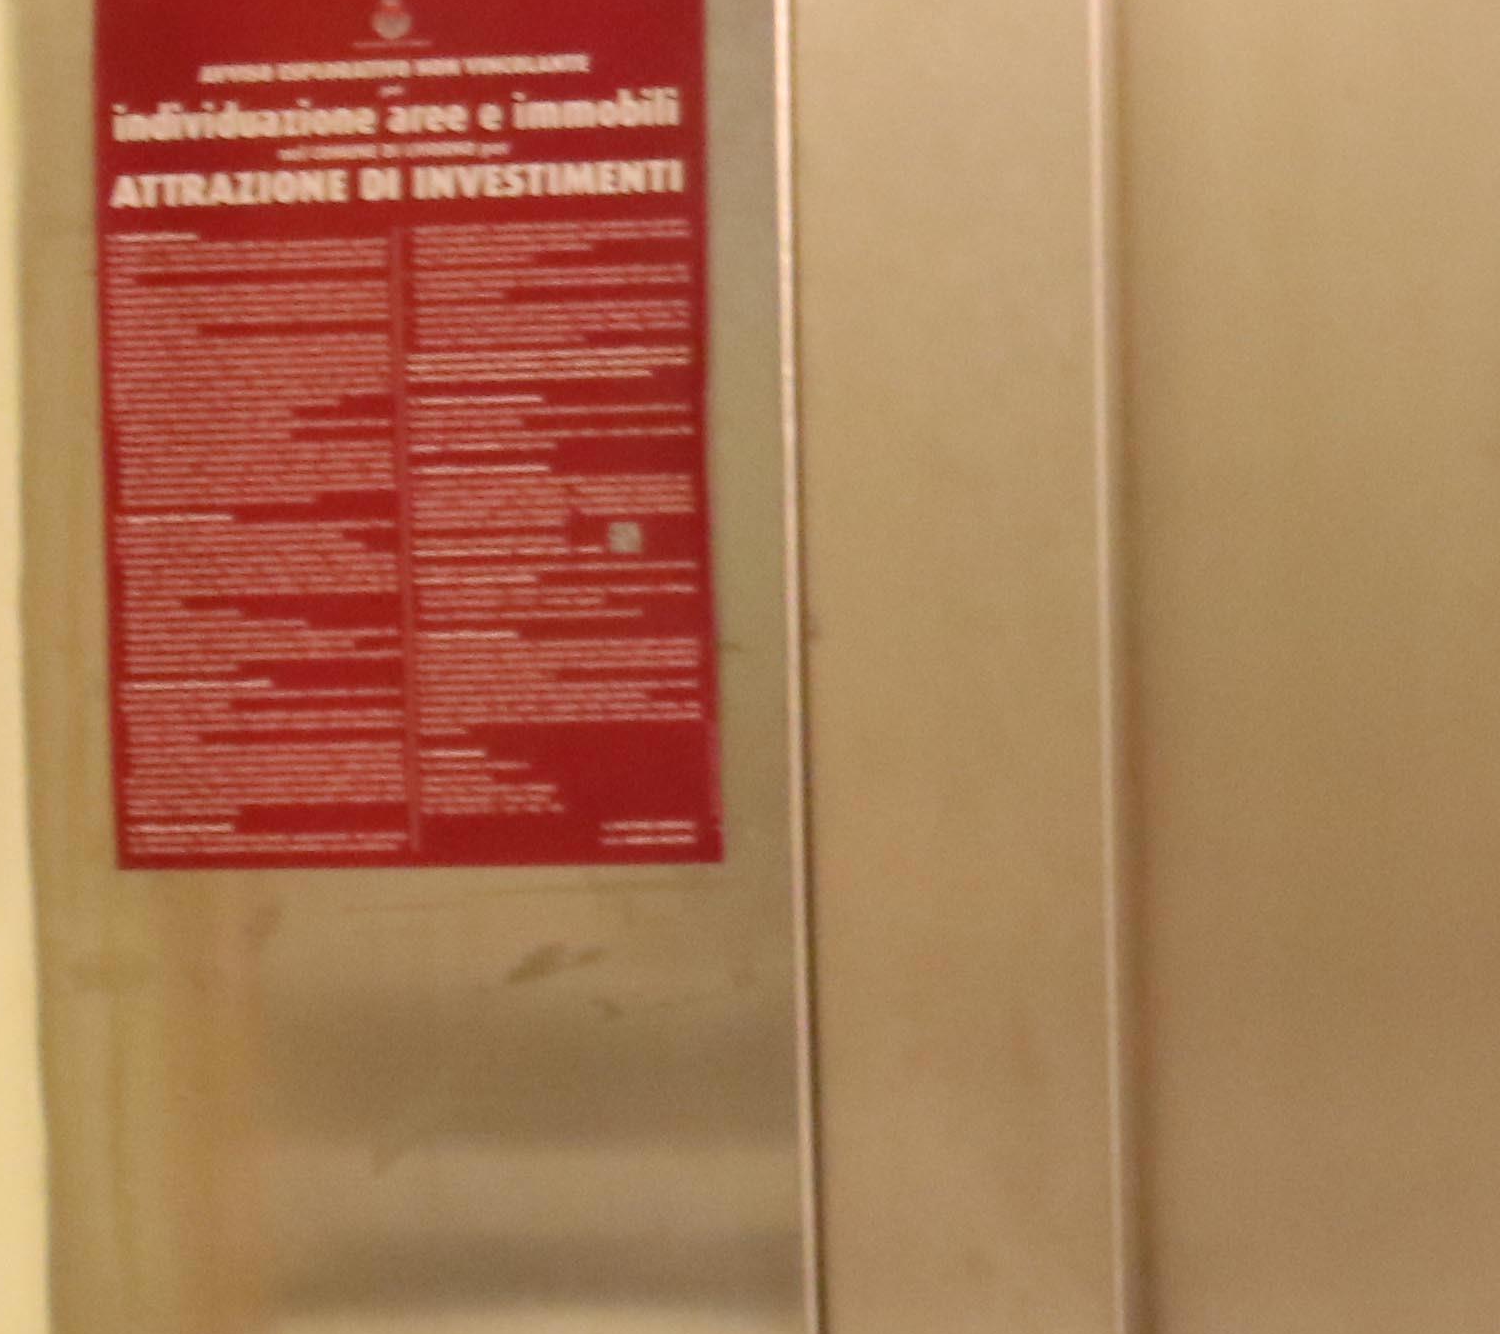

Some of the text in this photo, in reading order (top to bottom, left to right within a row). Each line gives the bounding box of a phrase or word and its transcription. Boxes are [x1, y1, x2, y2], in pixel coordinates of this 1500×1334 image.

[112, 86, 680, 142] individuazione aree e immobili
[109, 158, 684, 208] ATTRAZIONE DI INVESTIMENTI
